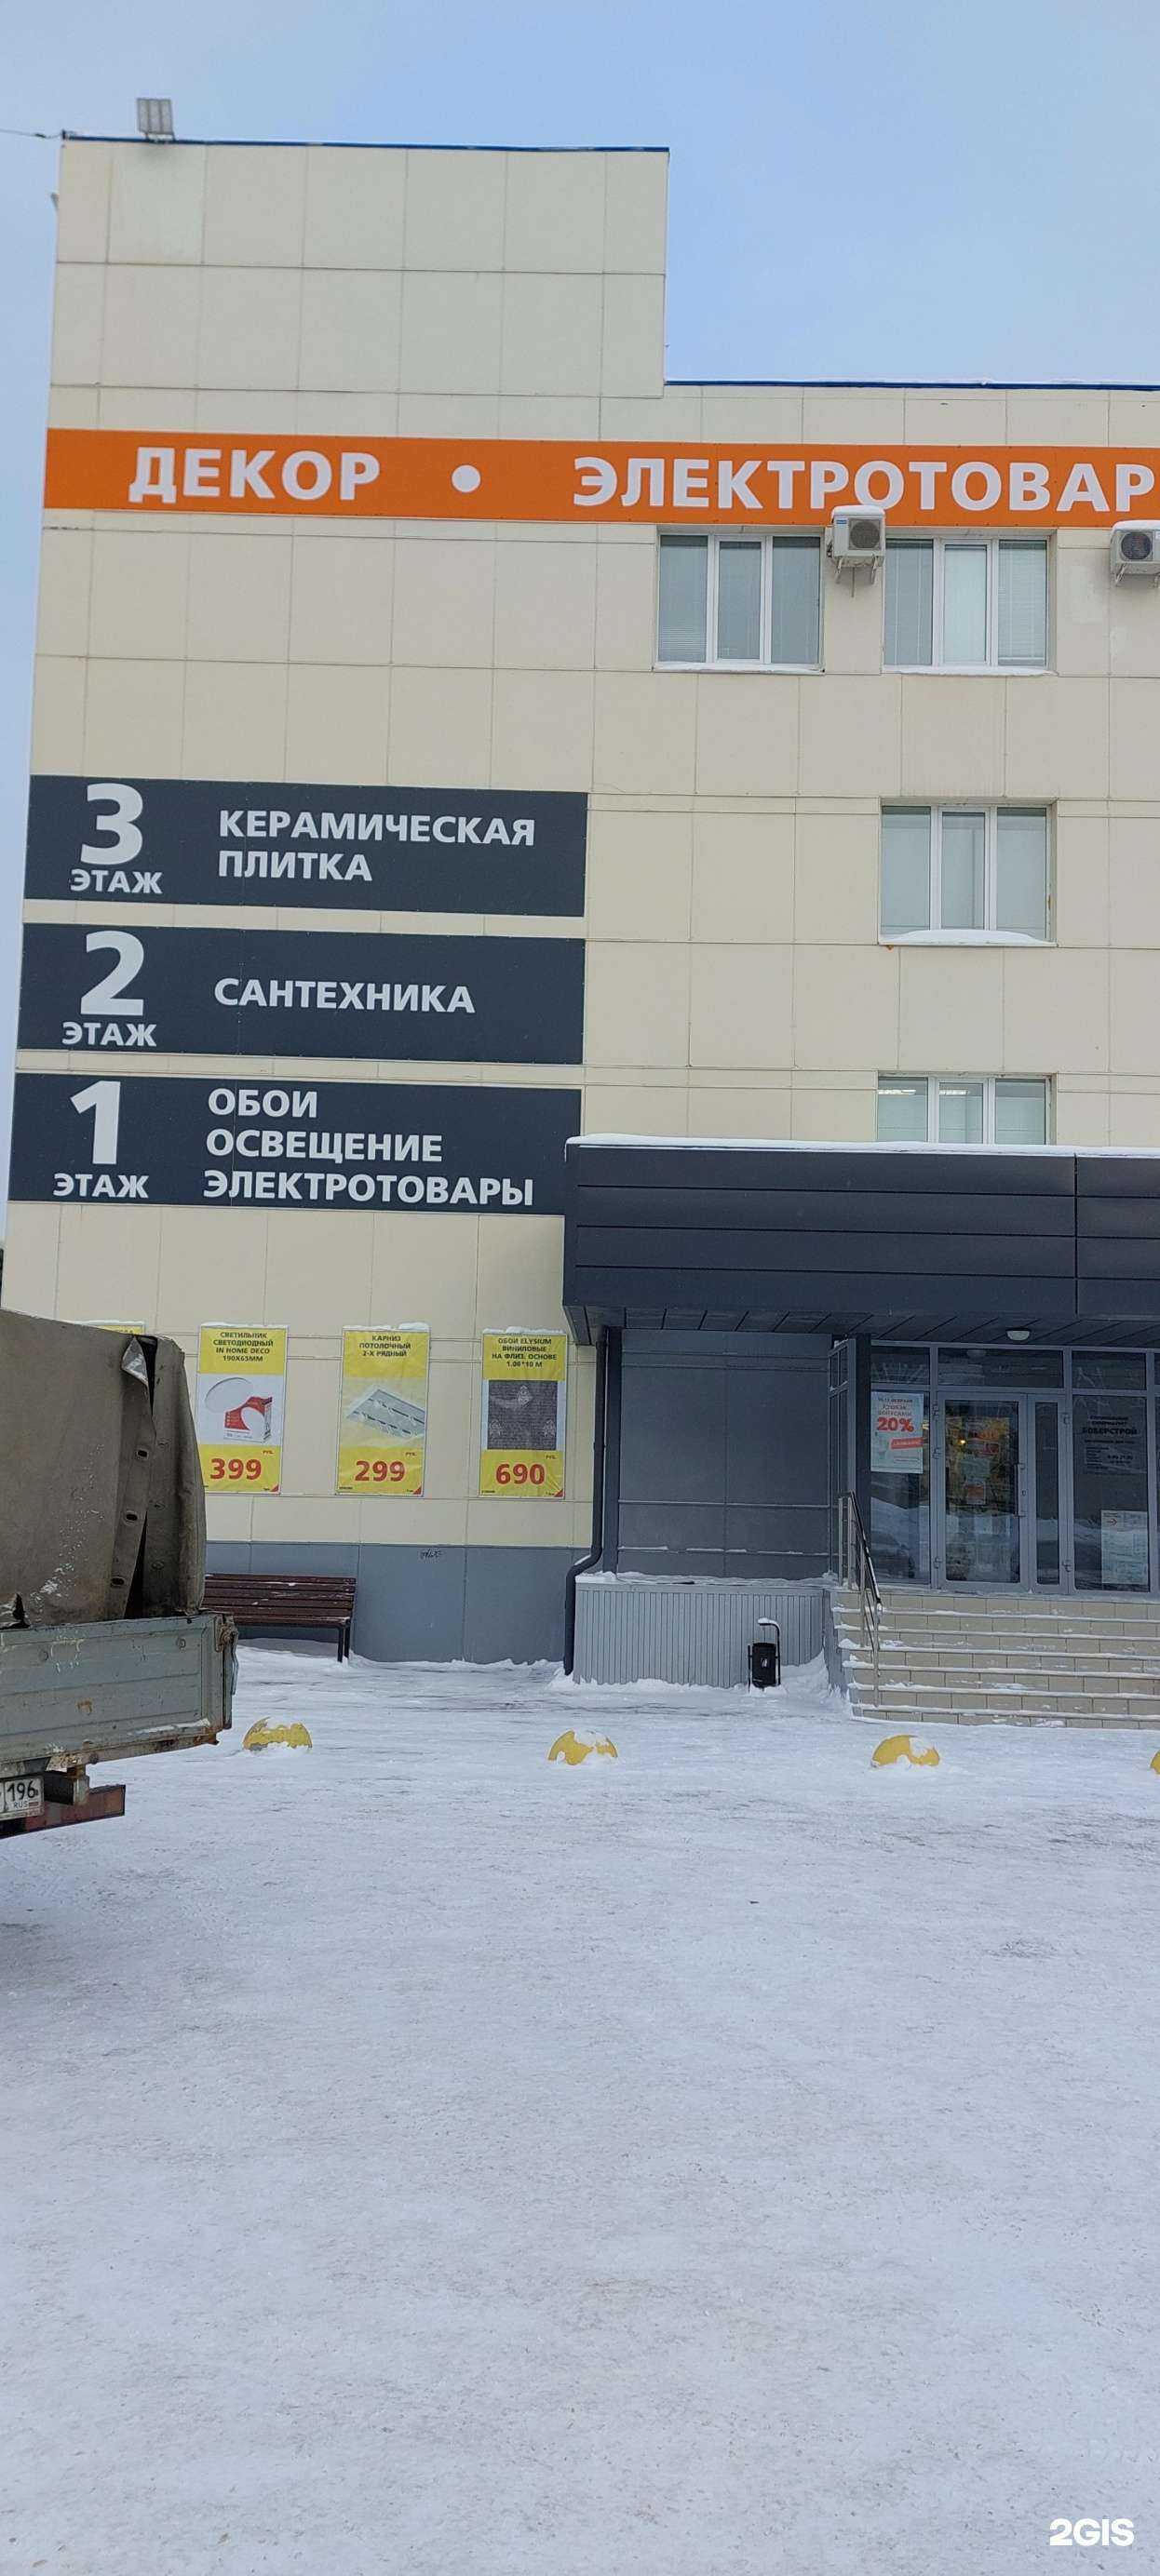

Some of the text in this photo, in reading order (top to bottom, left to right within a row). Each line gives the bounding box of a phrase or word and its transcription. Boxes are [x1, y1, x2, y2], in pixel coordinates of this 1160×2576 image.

[128, 447, 1155, 513] ДЕКОР ЭЛЕКТРОТОВАР
[80, 783, 143, 865] 3
[219, 810, 535, 846] КЕРАМИЧЕСКАЯ
[70, 868, 163, 894] ЭТАЖ
[218, 851, 373, 881] ПЛИТКА
[80, 931, 144, 1016] 2
[214, 977, 476, 1013] САНТЕХНИКА
[61, 1022, 157, 1047] ЭТАЖ
[208, 1088, 317, 1119] ОБОИ
[70, 1080, 121, 1165] 1
[206, 1128, 442, 1164] ОСВЕЩЕНИЕ
[53, 1173, 149, 1199] ЭТАЖ
[203, 1169, 533, 1207] ЭЛЕКТРОТОВАРЫ
[877, 1416, 914, 1432] 20%
[210, 1458, 262, 1480] 399
[355, 1460, 405, 1482] 299
[496, 1463, 546, 1484] 690
[7, 1780, 35, 1802] 196
